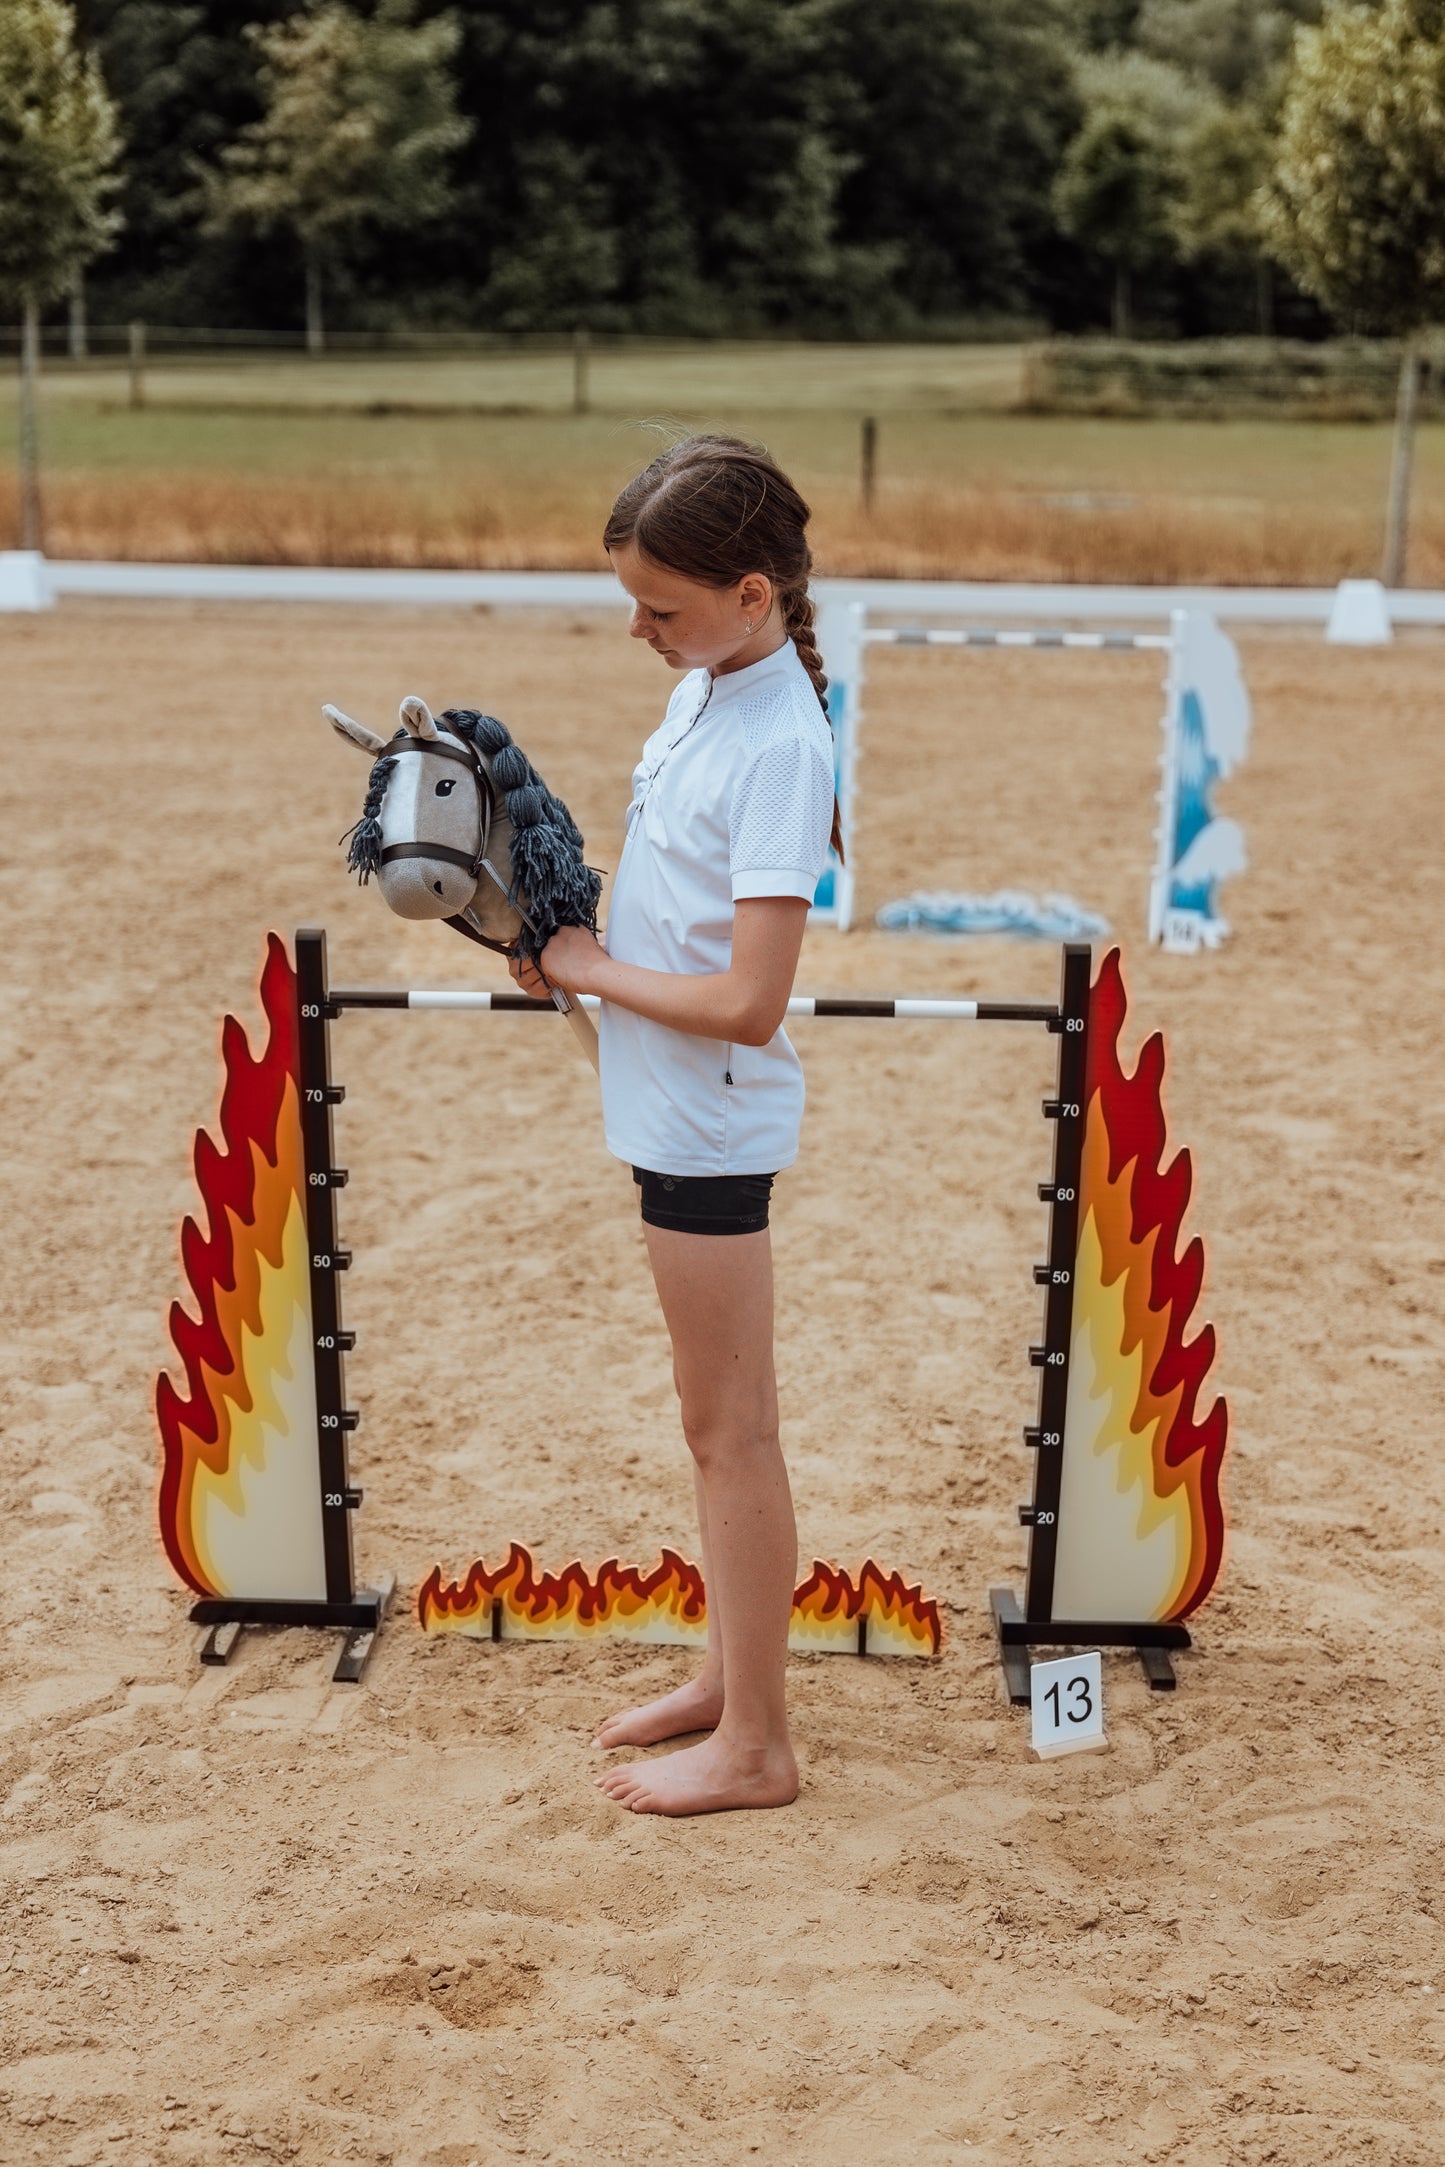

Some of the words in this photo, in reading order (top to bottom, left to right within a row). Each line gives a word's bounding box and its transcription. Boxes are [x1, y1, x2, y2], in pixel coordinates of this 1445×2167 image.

[301, 1004, 319, 1017] 80
[1066, 1018, 1084, 1032] 80
[305, 1089, 323, 1102] 70
[1062, 1104, 1080, 1117] 70
[309, 1173, 327, 1186] 60
[1057, 1188, 1075, 1201] 60
[313, 1255, 331, 1268] 50
[1052, 1271, 1070, 1284] 50
[317, 1335, 335, 1348] 40
[1047, 1352, 1065, 1365] 40
[321, 1415, 339, 1428] 30
[1042, 1432, 1060, 1445] 30
[325, 1494, 342, 1507] 20
[1037, 1512, 1055, 1525] 20
[1044, 1676, 1093, 1728] 13
